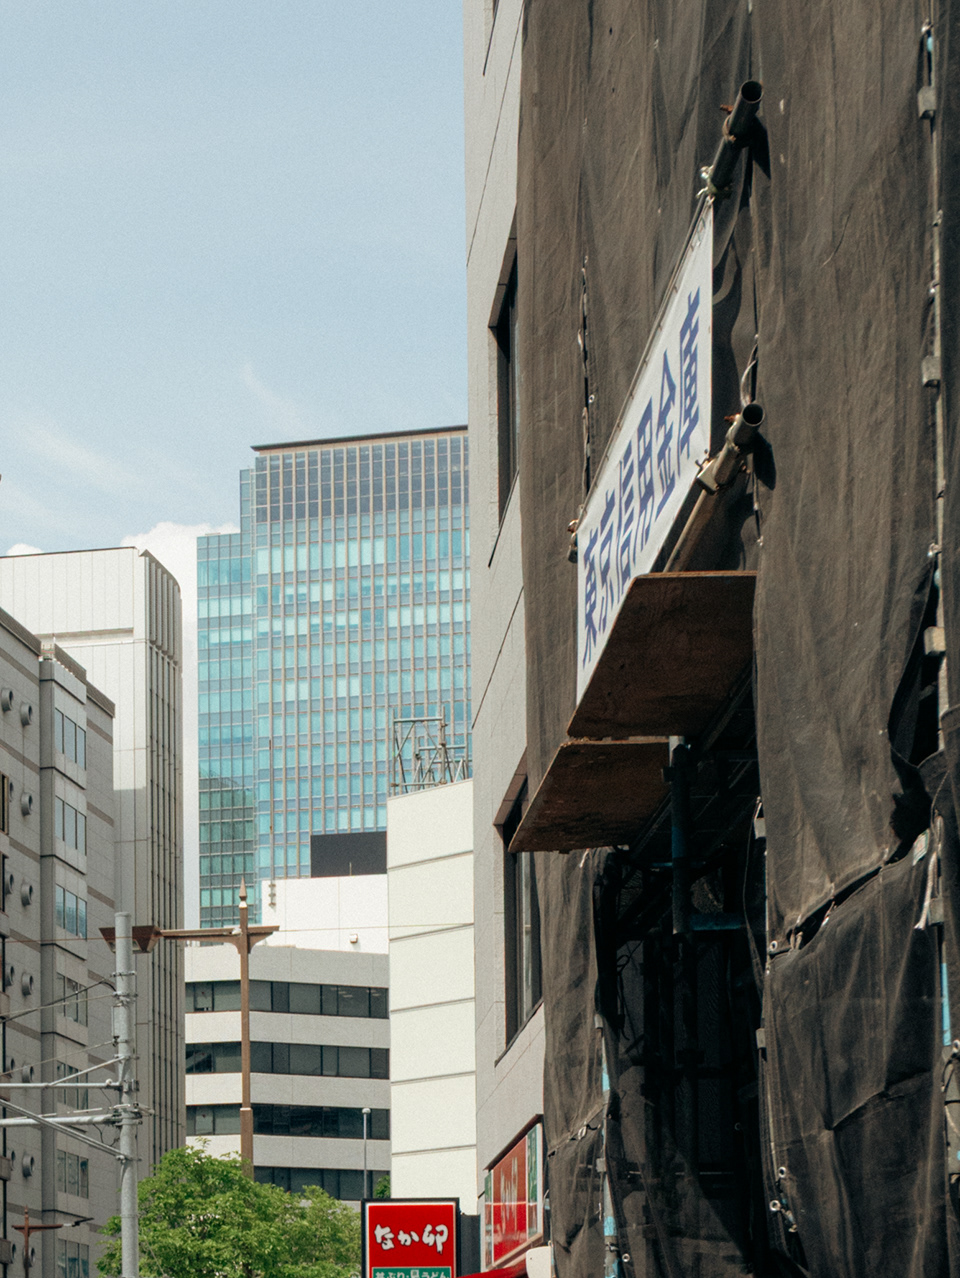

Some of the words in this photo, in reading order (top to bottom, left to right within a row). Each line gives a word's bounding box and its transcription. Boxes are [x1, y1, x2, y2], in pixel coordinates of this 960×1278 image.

[582, 286, 701, 668] 東京信用金庫
[374, 1223, 449, 1255] なか卯
